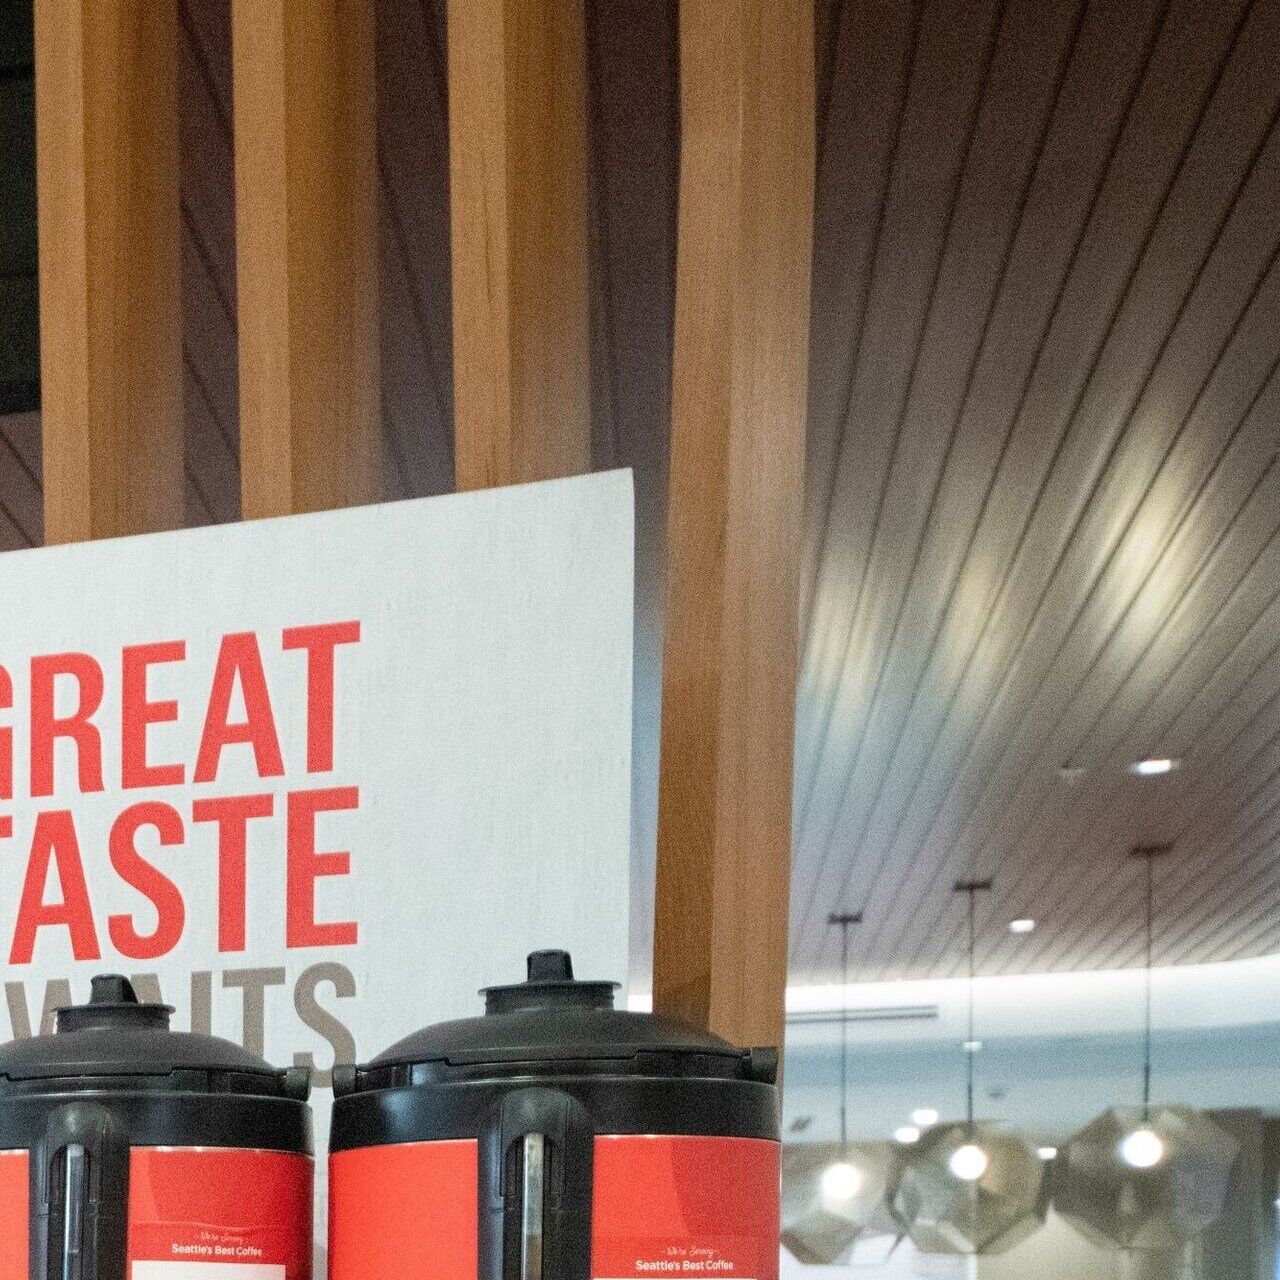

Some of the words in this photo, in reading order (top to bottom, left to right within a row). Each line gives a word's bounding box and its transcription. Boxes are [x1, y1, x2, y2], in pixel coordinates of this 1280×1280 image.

[171, 1243, 213, 1255] Seattle's
[214, 1245, 236, 1256] Best
[236, 1246, 263, 1257] Coffee
[635, 1259, 681, 1271] Seattle's
[682, 1259, 705, 1271] Best
[705, 1259, 734, 1271] Coffee
